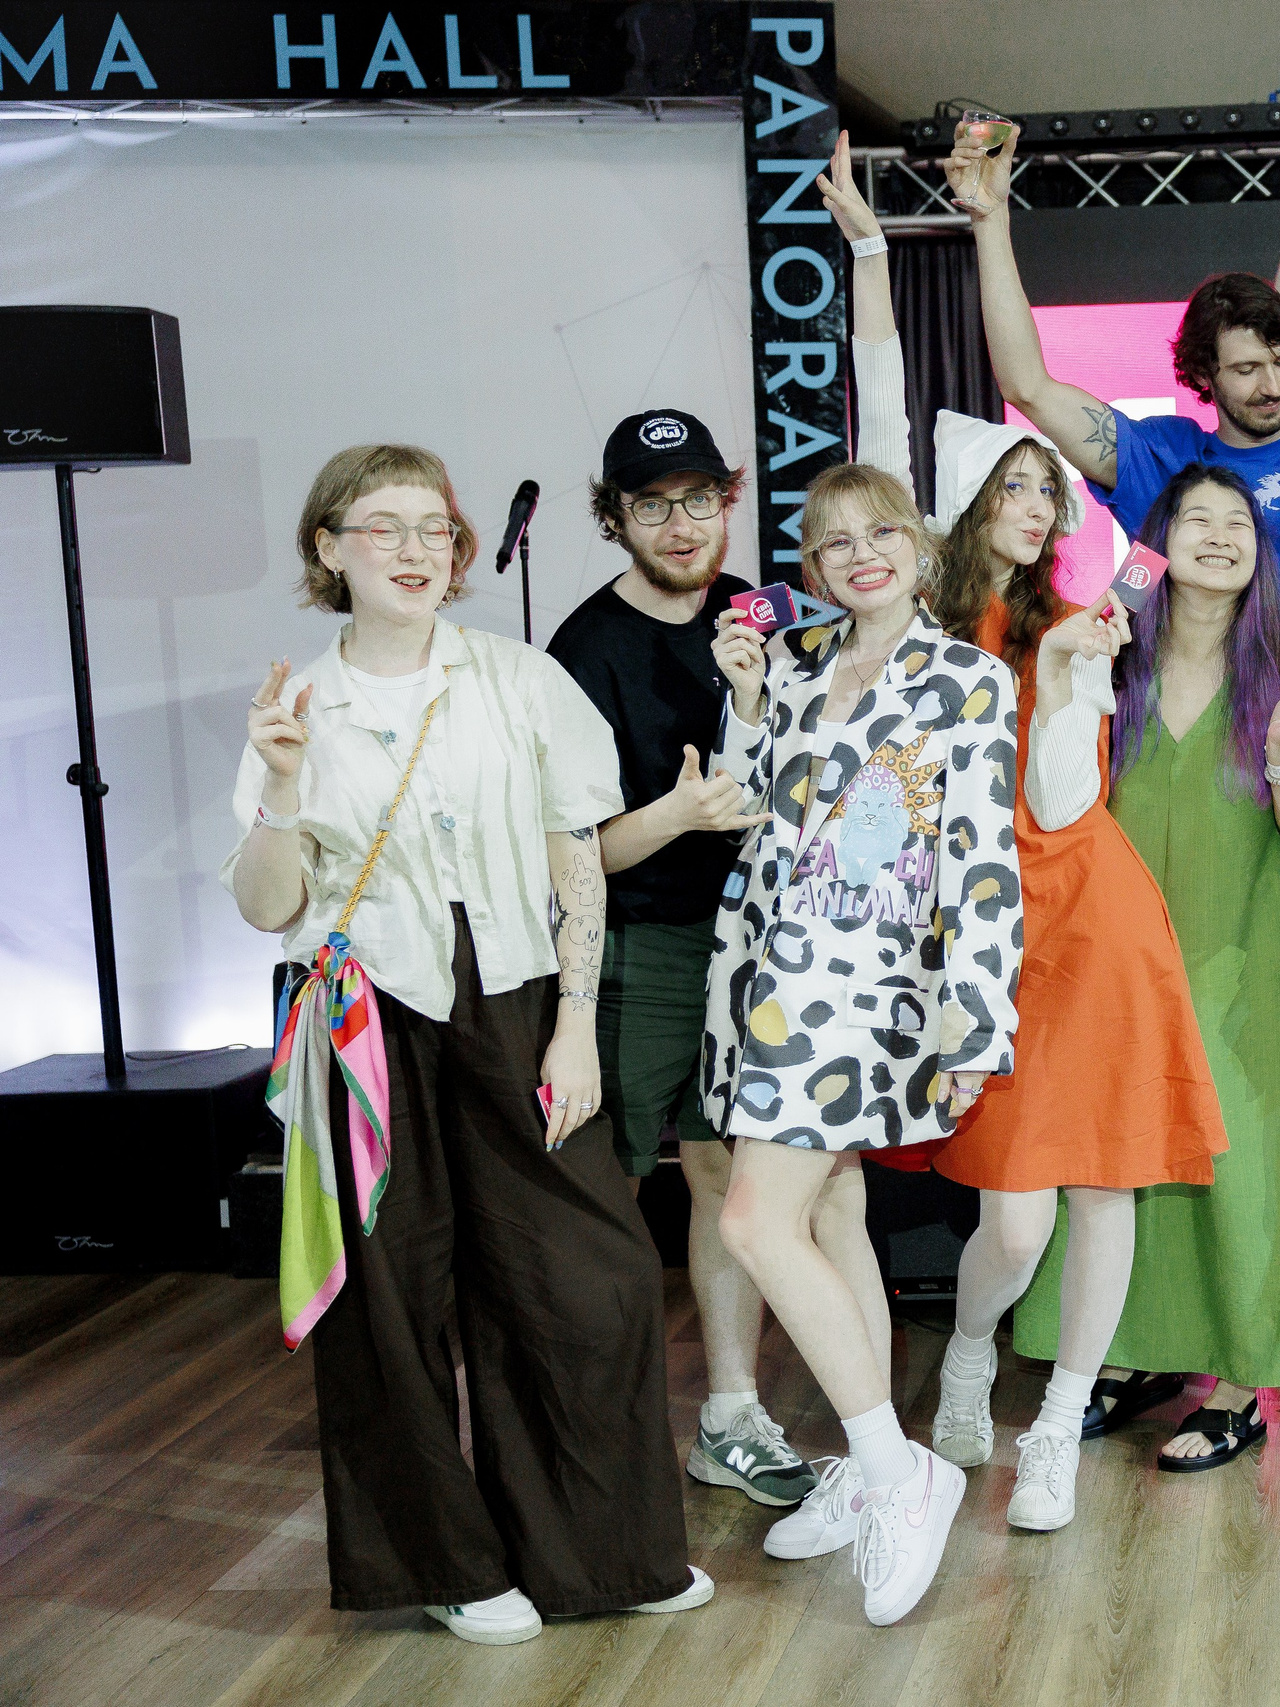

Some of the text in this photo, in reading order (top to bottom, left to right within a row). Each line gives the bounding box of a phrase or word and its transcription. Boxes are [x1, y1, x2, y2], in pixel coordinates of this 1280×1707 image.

[273, 13, 570, 89] HALL
[790, 876, 930, 929] ANIMAL
[725, 1445, 757, 1474] N
